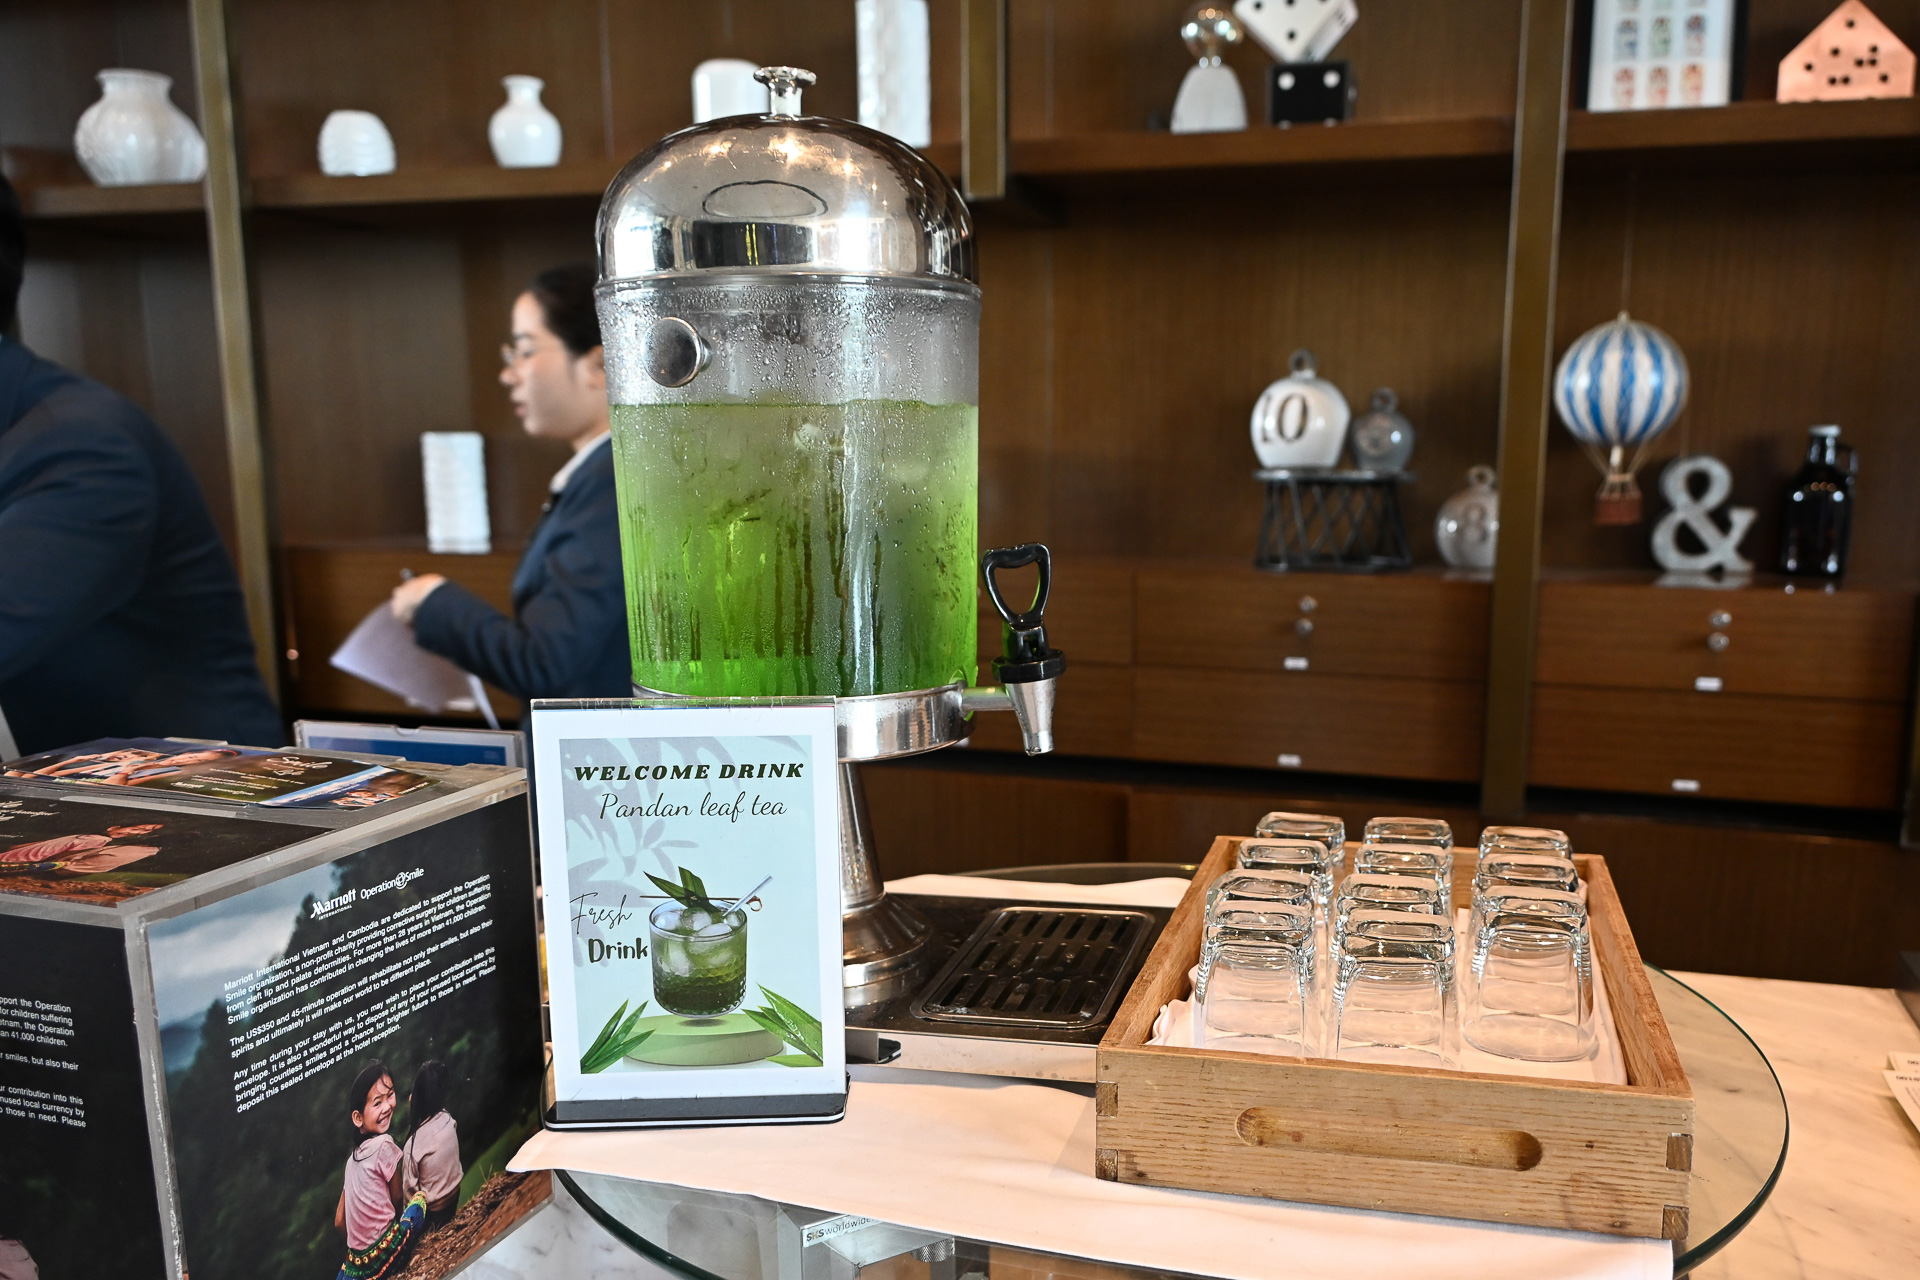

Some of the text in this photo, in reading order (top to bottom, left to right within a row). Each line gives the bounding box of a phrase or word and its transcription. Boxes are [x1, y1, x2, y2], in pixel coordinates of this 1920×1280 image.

[1261, 392, 1308, 444] 10
[1651, 455, 1757, 573] &
[574, 763, 804, 781] WELCOME DRINK
[599, 791, 787, 823] Pandan leaf tea
[360, 867, 425, 900] Operation Smile
[310, 888, 356, 919] Marriott
[319, 905, 353, 920] INTERNATIONAL
[570, 892, 632, 934] Fresh
[224, 873, 490, 990] Marriott International Vietnam and Cambodia are dedicated support the Operation
[225, 883, 490, 1002] Smile organization, non-profit charity providing corrective surgery for children suffering
[226, 892, 491, 1013] from cleft lip and palate deformities. For more than 28 years Vietnam, the Operation
[227, 904, 486, 1024] Smile organization has contributed changing the lives more than 41,000 children.
[588, 937, 648, 963] Drink
[229, 919, 493, 1046] The US$350 and 45-minute operation will rehabilitate not only their smiles, but also their
[11, 1008, 73, 1026] children suffering
[20, 998, 32, 1007] the
[35, 1000, 71, 1012] Operation
[231, 958, 431, 1058] spirits and ultimately will make our world different place.
[233, 946, 495, 1080] Any time during your stay with us, you may wish place your contribution into this
[11, 1030, 35, 1041] 41,000
[24, 1021, 74, 1036] the Operation
[234, 959, 488, 1091] envelope. also wonderful way dispose any your unused local currency
[235, 964, 496, 1102] bringing countless smiles and chance for brighter future those need. Please
[32, 1056, 43, 1064] but
[46, 1058, 60, 1066] also
[62, 1061, 78, 1069] their
[236, 1023, 401, 1113] deposit this sealed envelope the hotel reception.
[8, 1086, 50, 1099] contribution
[53, 1092, 67, 1101] into
[70, 1095, 83, 1104] this
[23, 1098, 40, 1108] local
[42, 1103, 73, 1116] currency
[6, 1107, 25, 1117] those
[62, 1115, 86, 1127] Please
